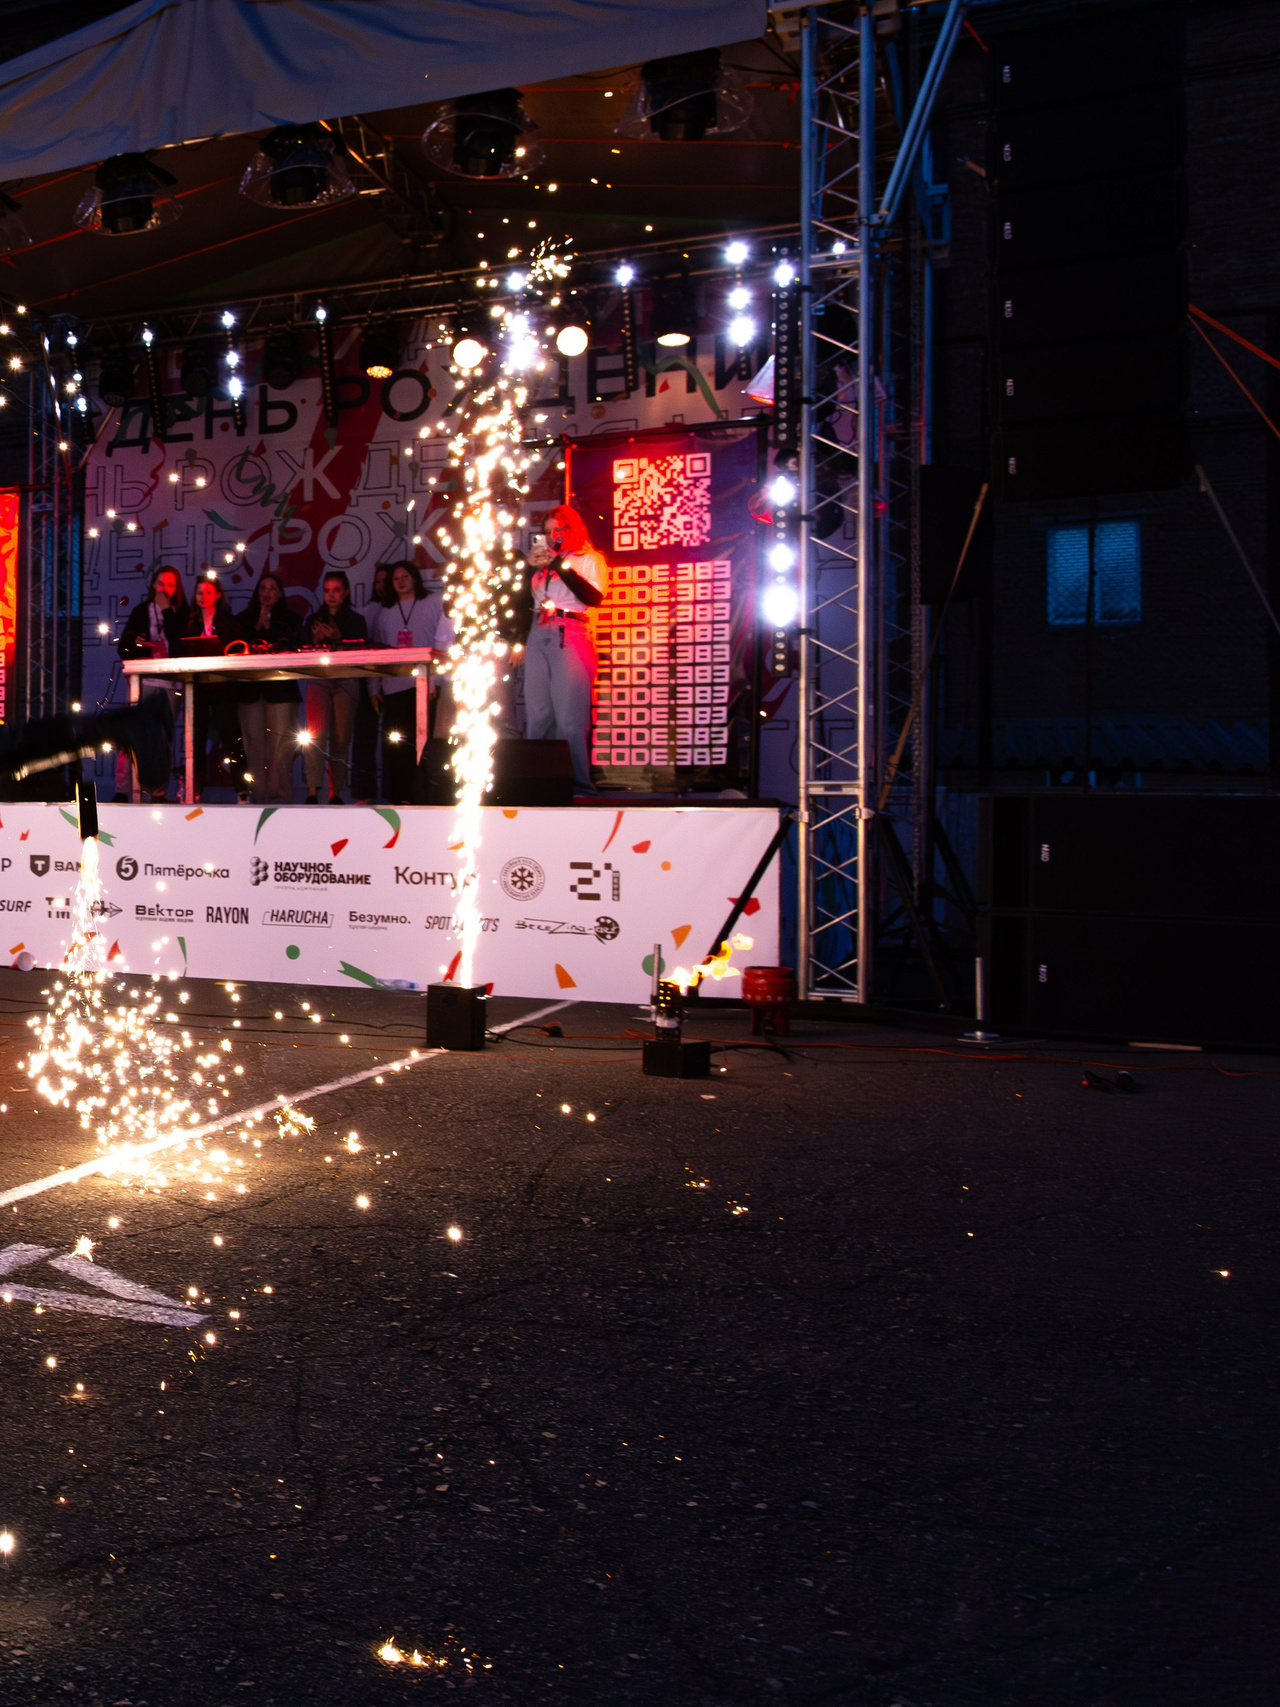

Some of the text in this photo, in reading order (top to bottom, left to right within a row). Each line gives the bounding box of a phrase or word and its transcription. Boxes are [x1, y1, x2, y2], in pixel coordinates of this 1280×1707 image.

[593, 664, 729, 686] CODE.383
[591, 685, 729, 707] CODE.383
[591, 706, 728, 727] CODE.383
[591, 727, 728, 747] CODE.383
[591, 747, 727, 767] CODE.383
[144, 863, 230, 881] Пятёрочка
[274, 861, 333, 873] НАУЧНОЕ
[274, 872, 371, 885] ОБОРУДОВАНИЕ
[206, 906, 249, 924] RAYON
[270, 909, 329, 924] HARUCHA
[349, 910, 411, 925] Безумно.
